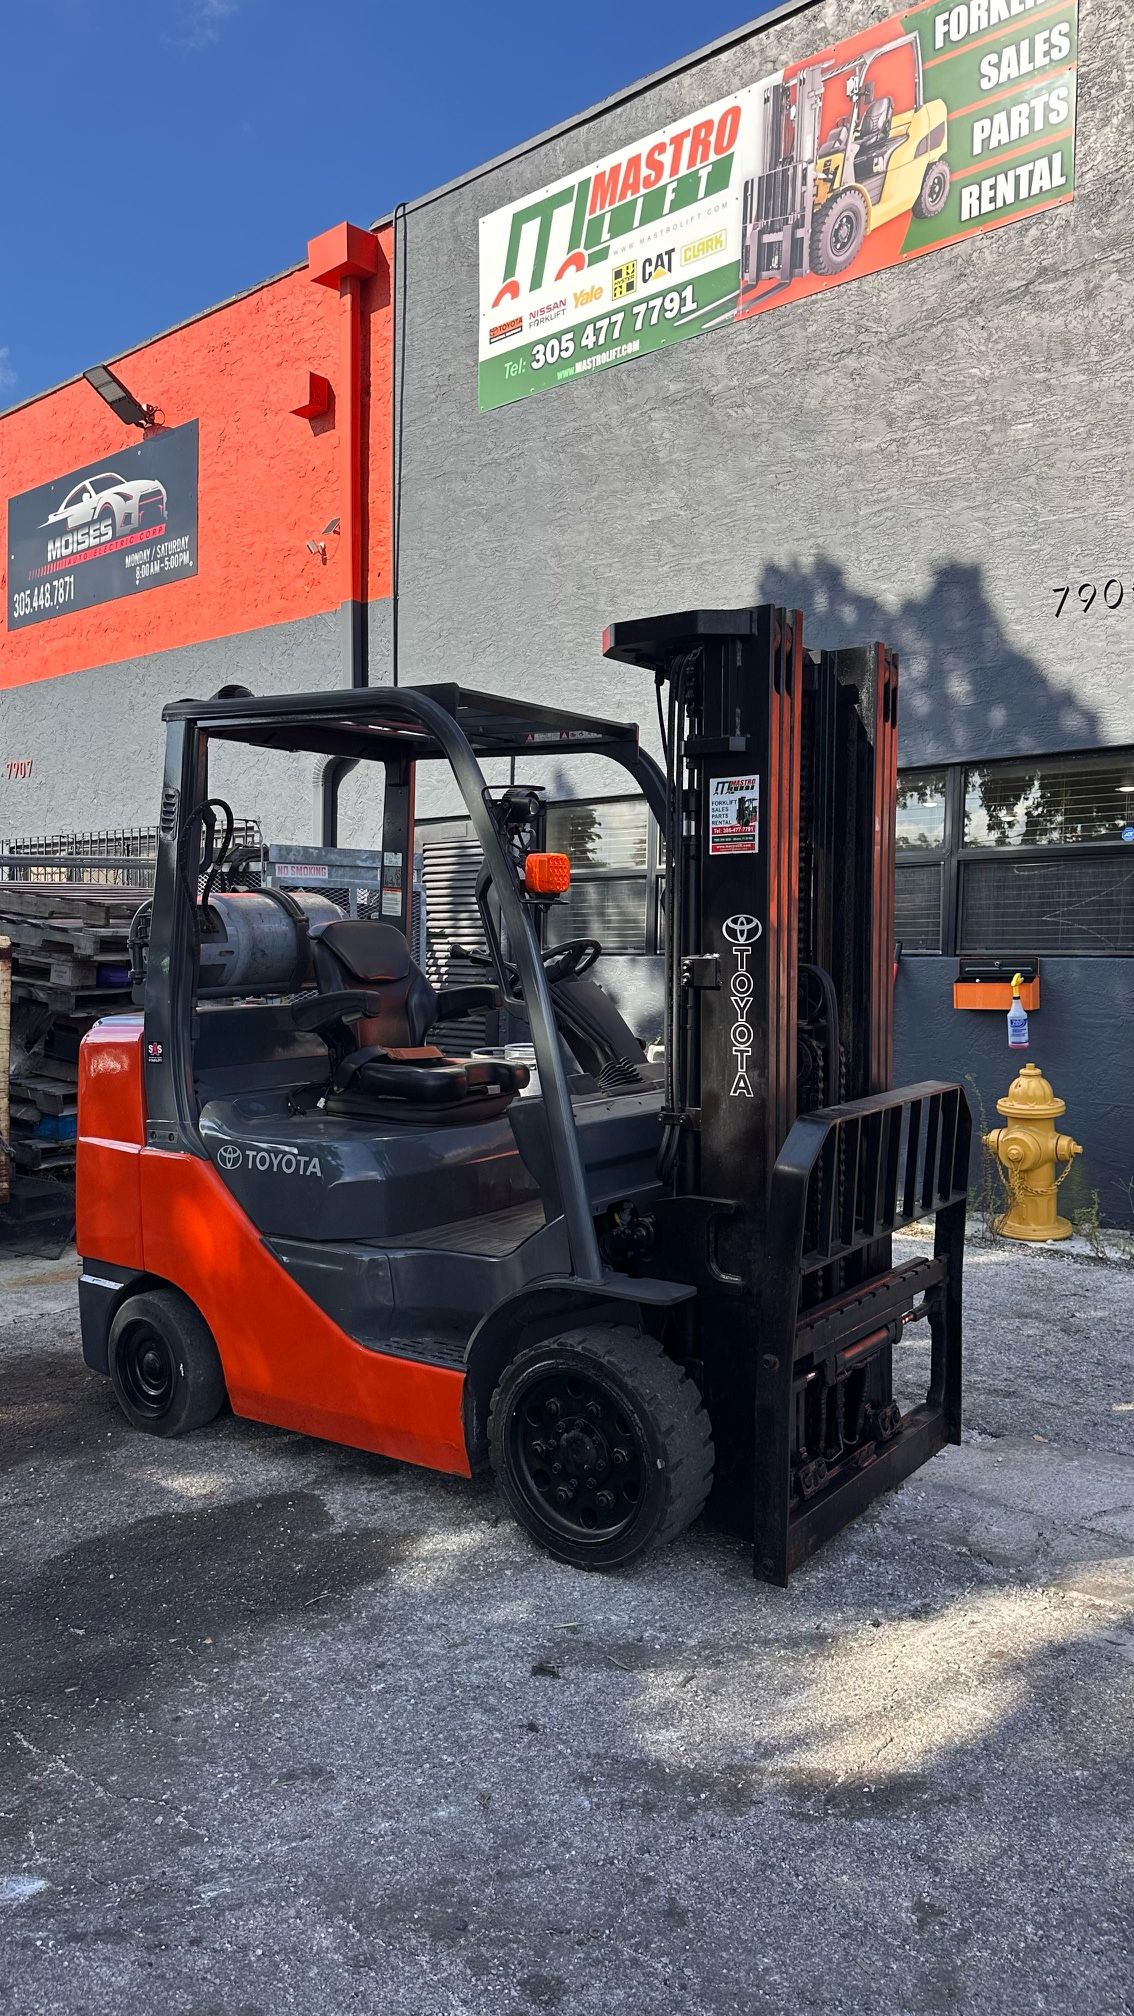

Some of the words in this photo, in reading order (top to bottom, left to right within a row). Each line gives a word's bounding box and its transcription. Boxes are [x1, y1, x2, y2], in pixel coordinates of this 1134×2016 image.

[979, 21, 1071, 91] SALES
[972, 86, 1069, 157] PARTS
[588, 105, 742, 216] MASTRO
[600, 164, 712, 242] LIFT
[960, 151, 1067, 222] RENTAL
[641, 247, 676, 284] CAT
[683, 232, 723, 262] CLARK
[528, 298, 567, 320] NISSAN
[572, 284, 604, 309] Yale
[498, 316, 523, 332] TOYOTA
[504, 358, 527, 379] Tel:
[530, 331, 575, 370] 305
[580, 311, 625, 350] 477
[632, 284, 698, 332] 7791
[528, 308, 567, 329] FORKLIFT
[47, 517, 113, 562] MOISES
[68, 553, 88, 566] AUTO
[93, 536, 135, 556] ELECTRIC
[139, 526, 163, 541] CORP
[125, 547, 151, 568] MONDAY
[156, 535, 190, 558] SATURDAY
[13, 574, 75, 618] 305.448.7871
[1052, 578, 1134, 618] 790
[730, 779, 756, 787] MASTRO
[712, 799, 737, 807] FORKLIFT
[277, 865, 289, 877] NO
[290, 865, 327, 877] SMOKING
[729, 946, 754, 1097] TOYOTA
[245, 1150, 322, 1177] TOYOTA
